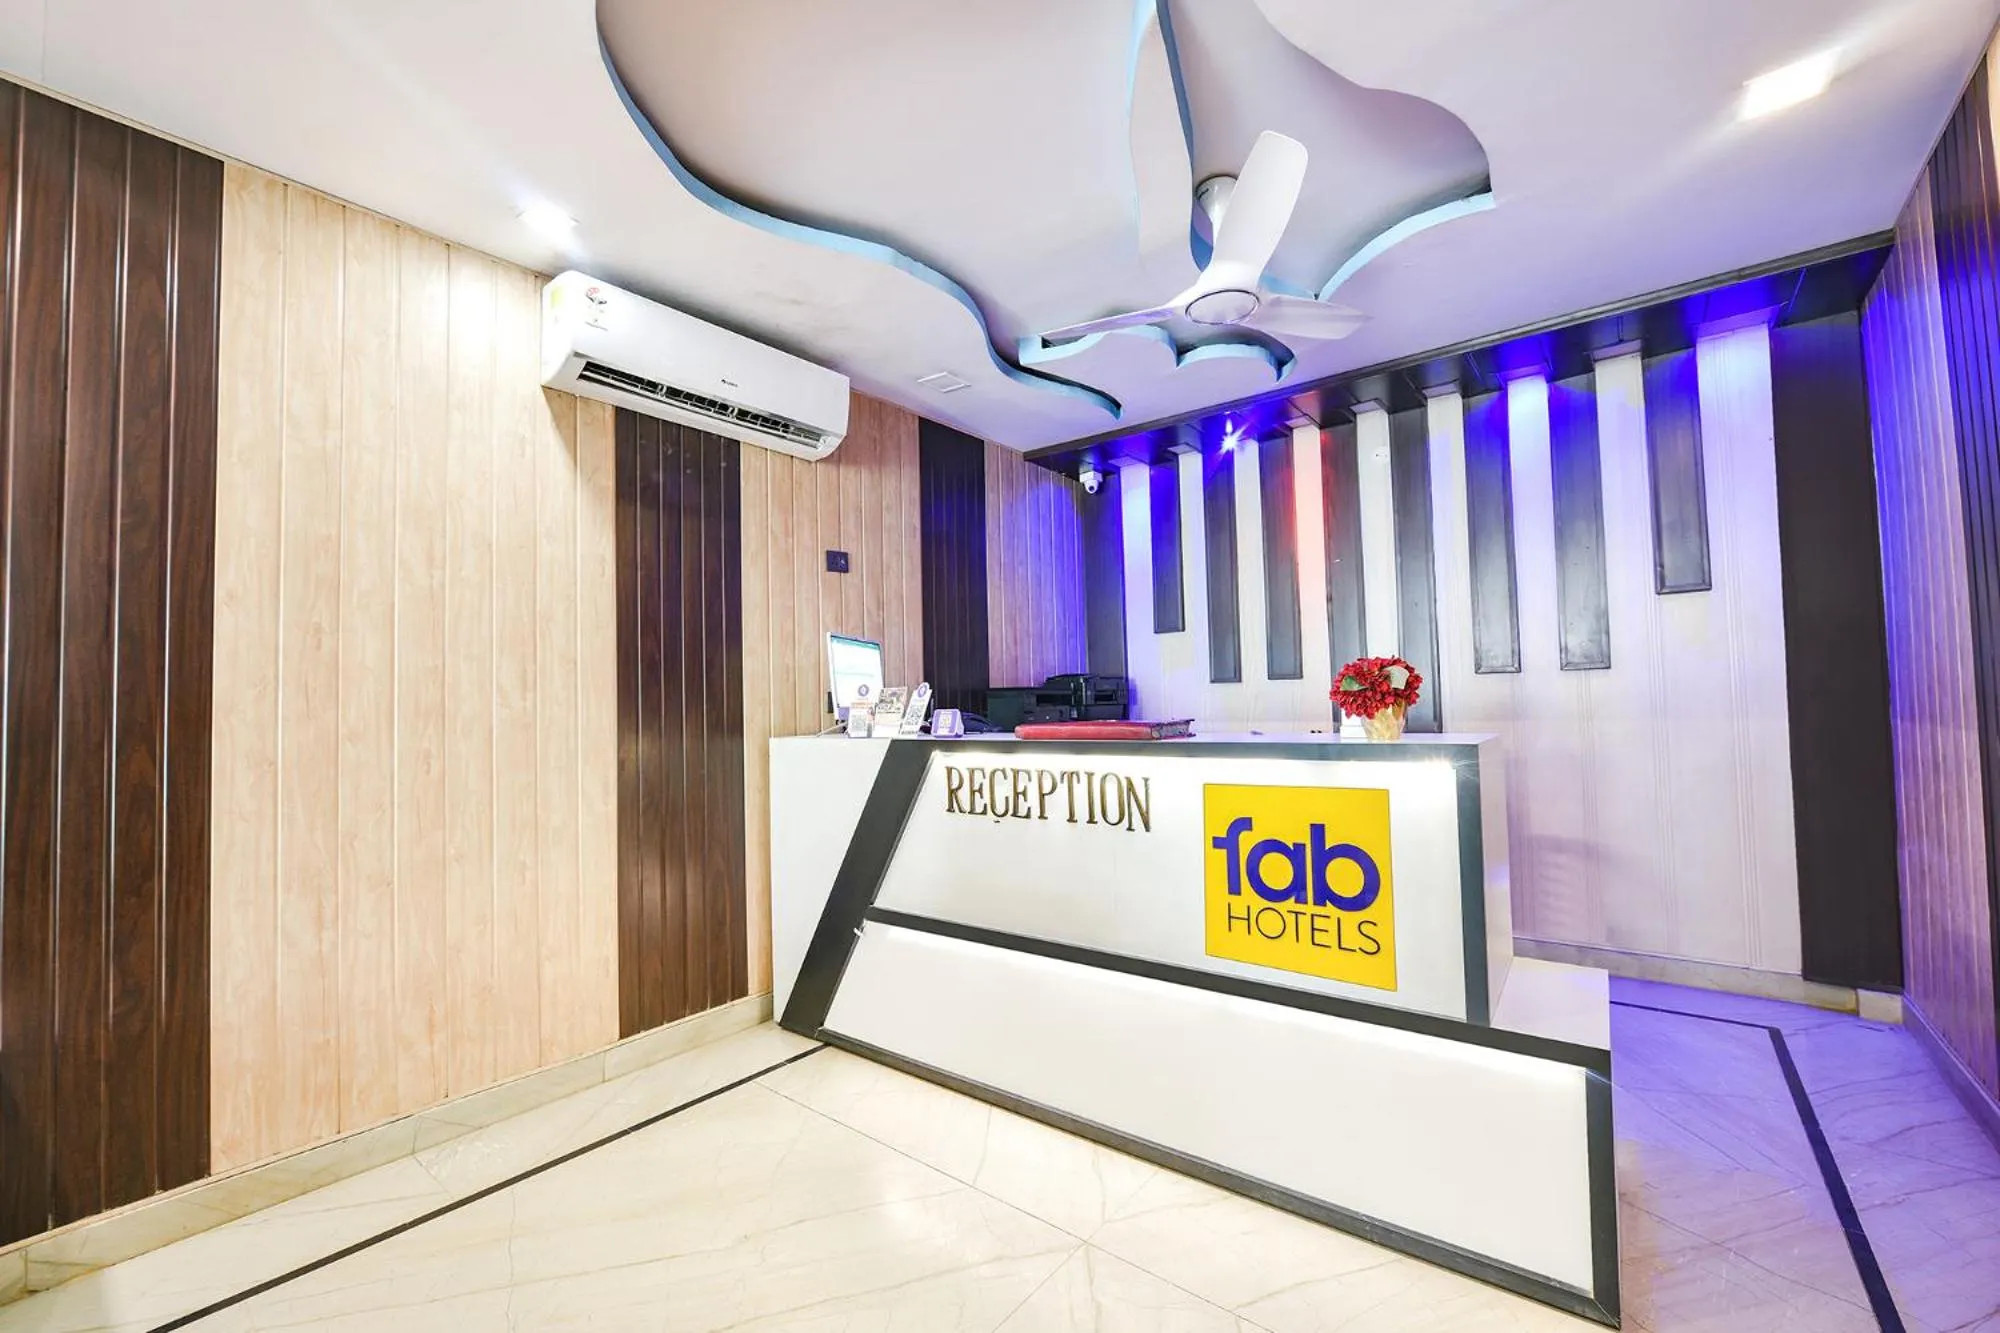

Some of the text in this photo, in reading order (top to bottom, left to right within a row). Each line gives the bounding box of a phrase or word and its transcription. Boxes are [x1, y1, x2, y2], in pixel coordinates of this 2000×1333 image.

[945, 766, 1151, 832] RECEPTION
[1212, 816, 1381, 912] fab
[1227, 902, 1381, 955] HOTELS
